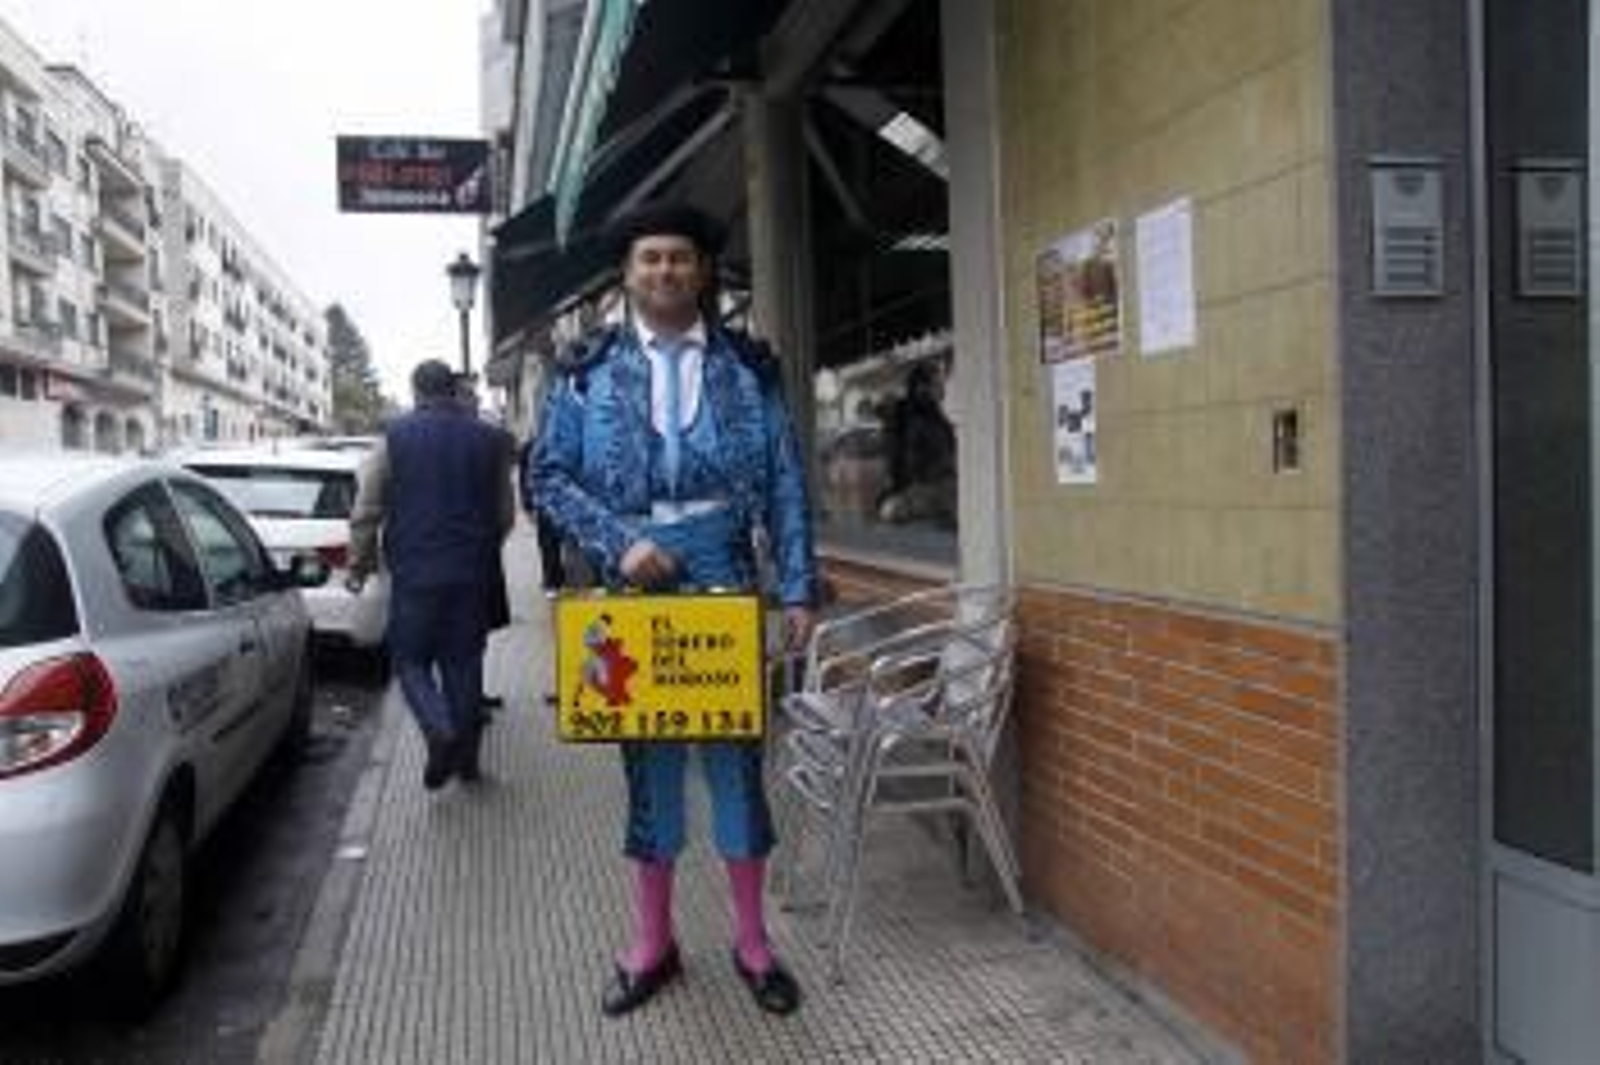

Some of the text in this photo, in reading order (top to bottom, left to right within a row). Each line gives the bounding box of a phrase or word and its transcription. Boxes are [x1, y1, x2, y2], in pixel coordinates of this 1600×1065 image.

[570, 709, 754, 736] 902 159 134
